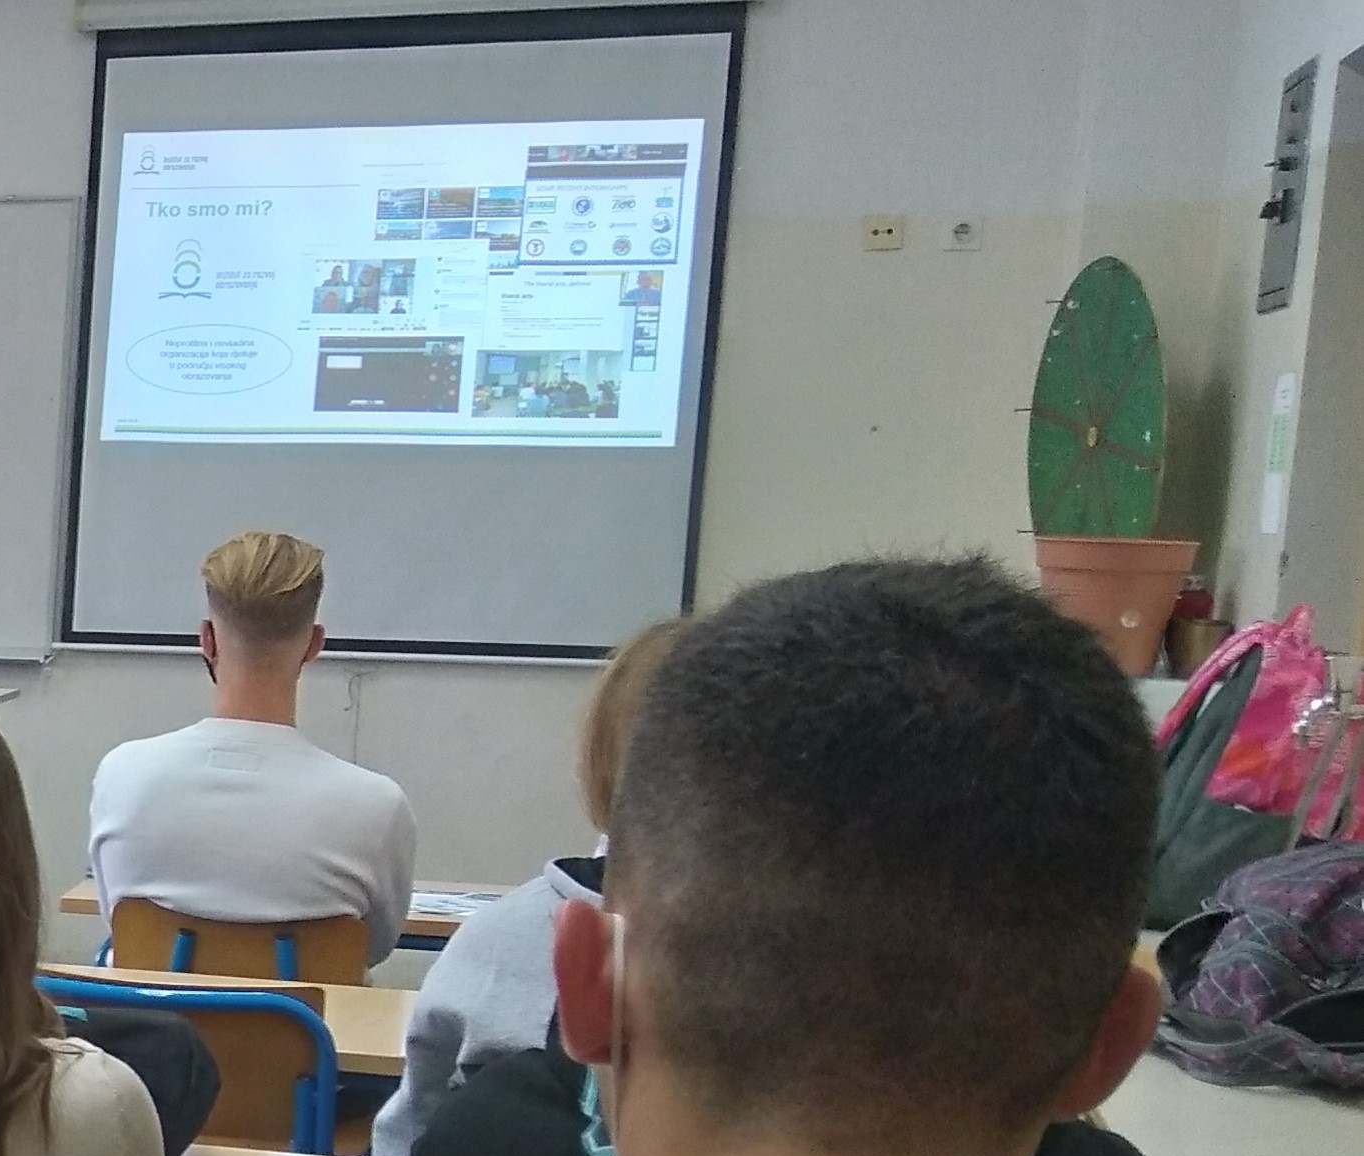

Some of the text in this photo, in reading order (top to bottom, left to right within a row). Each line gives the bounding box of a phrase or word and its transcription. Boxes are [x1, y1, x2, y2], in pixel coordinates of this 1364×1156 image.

[146, 200, 273, 217] Tko smo mi?
